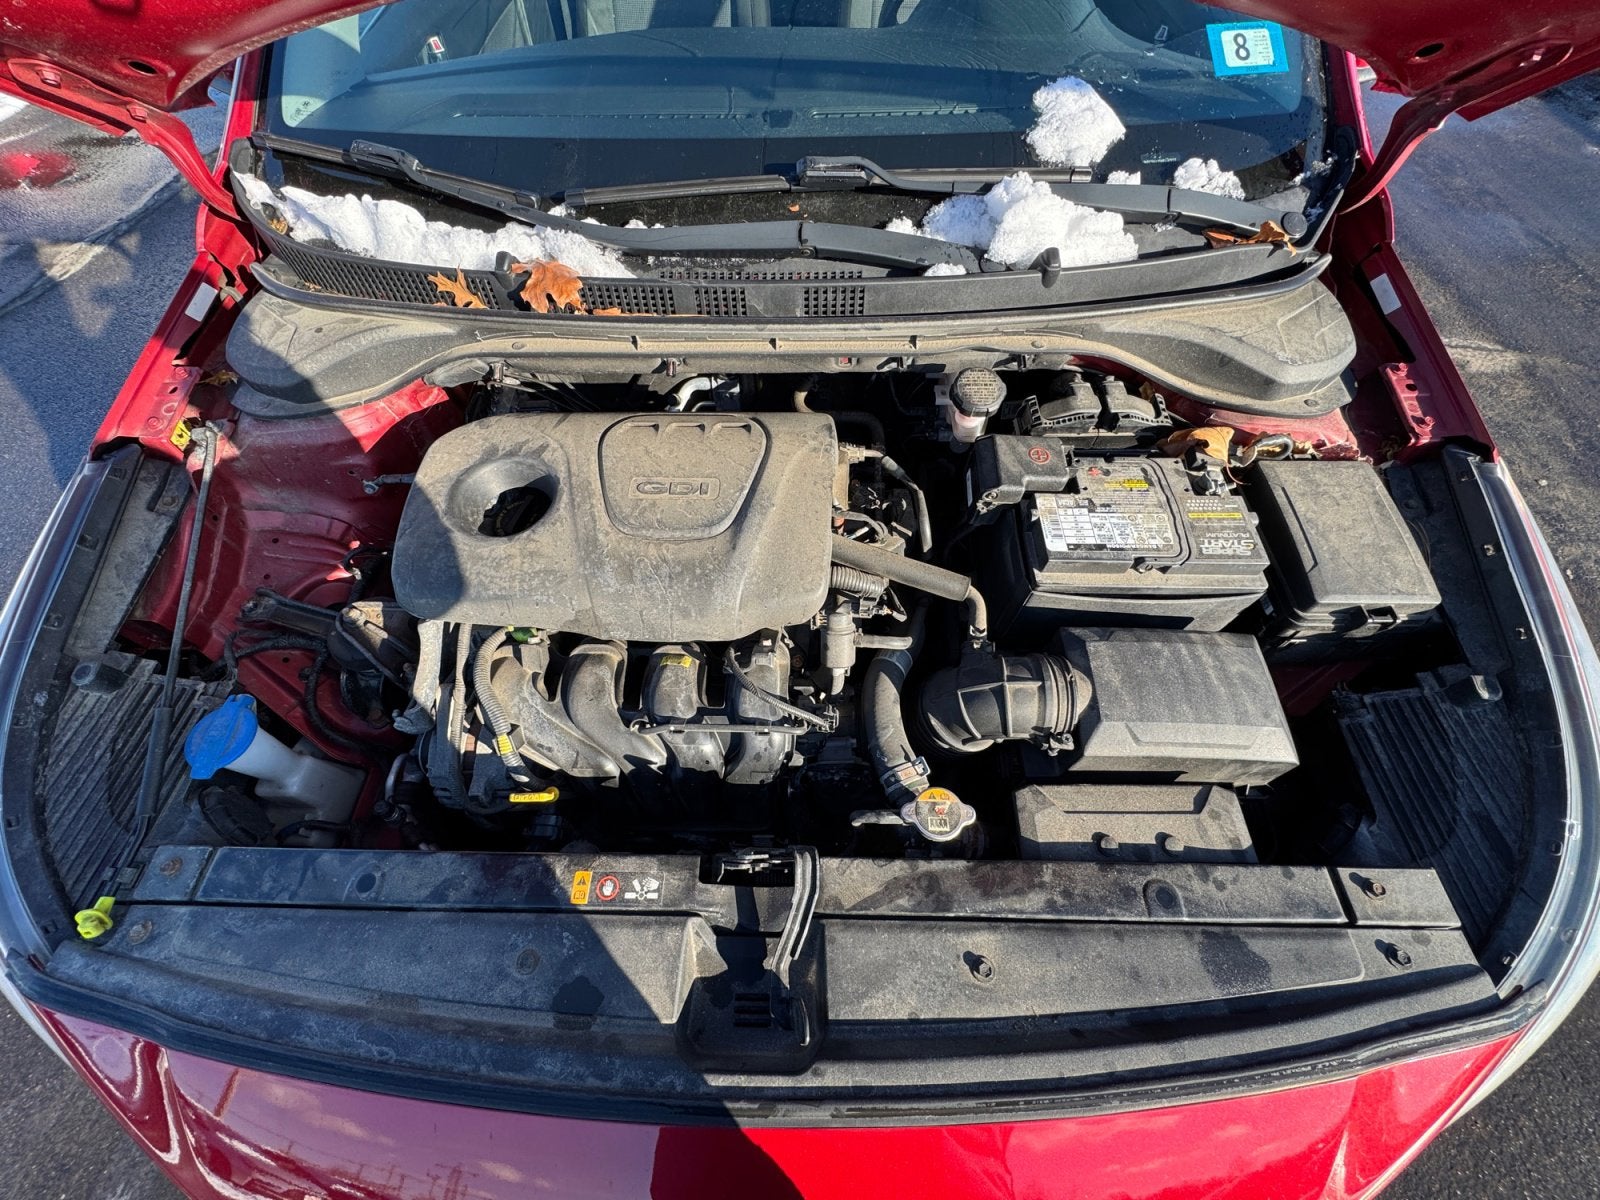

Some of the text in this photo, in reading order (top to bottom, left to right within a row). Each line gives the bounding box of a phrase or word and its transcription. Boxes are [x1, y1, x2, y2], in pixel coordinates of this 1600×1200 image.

[1233, 33, 1250, 61] 8
[636, 481, 710, 495] GDI
[1200, 539, 1255, 549] START
[1201, 547, 1251, 556] SUPER
